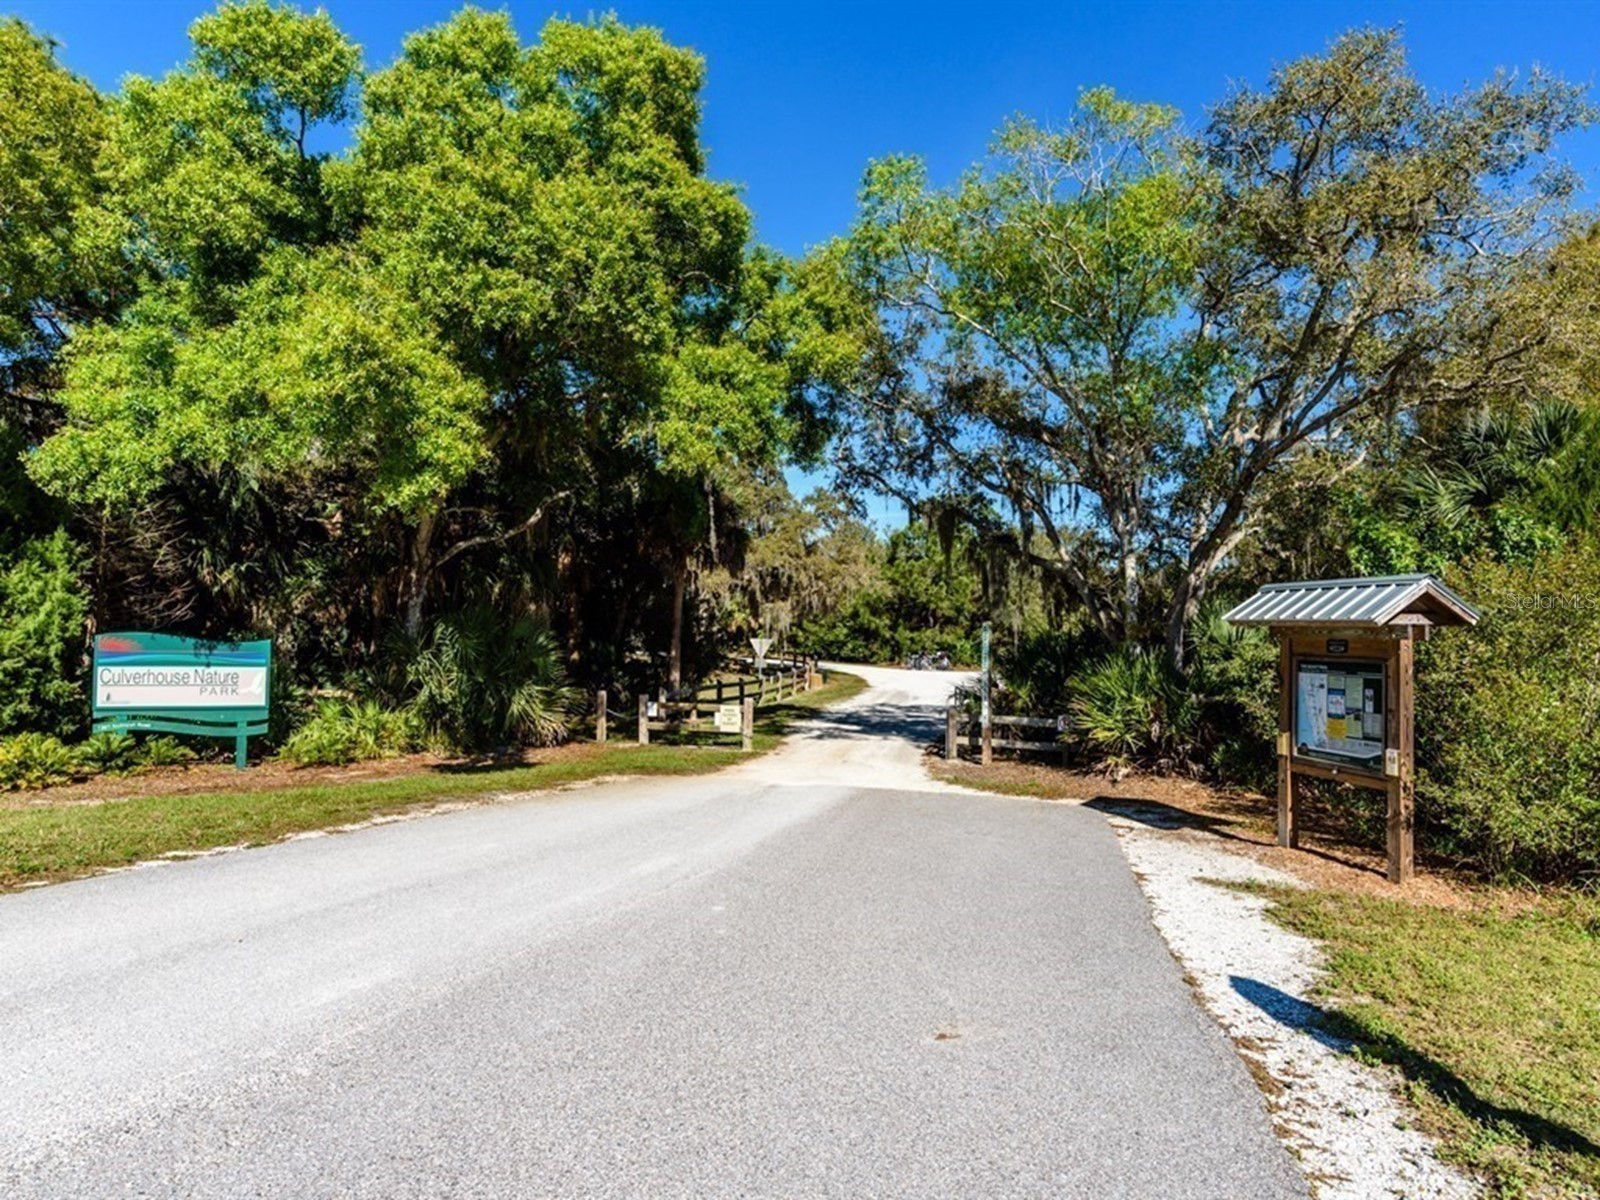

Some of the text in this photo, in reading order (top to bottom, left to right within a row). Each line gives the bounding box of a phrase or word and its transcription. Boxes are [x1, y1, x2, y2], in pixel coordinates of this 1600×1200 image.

[99, 667, 240, 685] Culverhouse Nature
[199, 686, 240, 696] PARK
